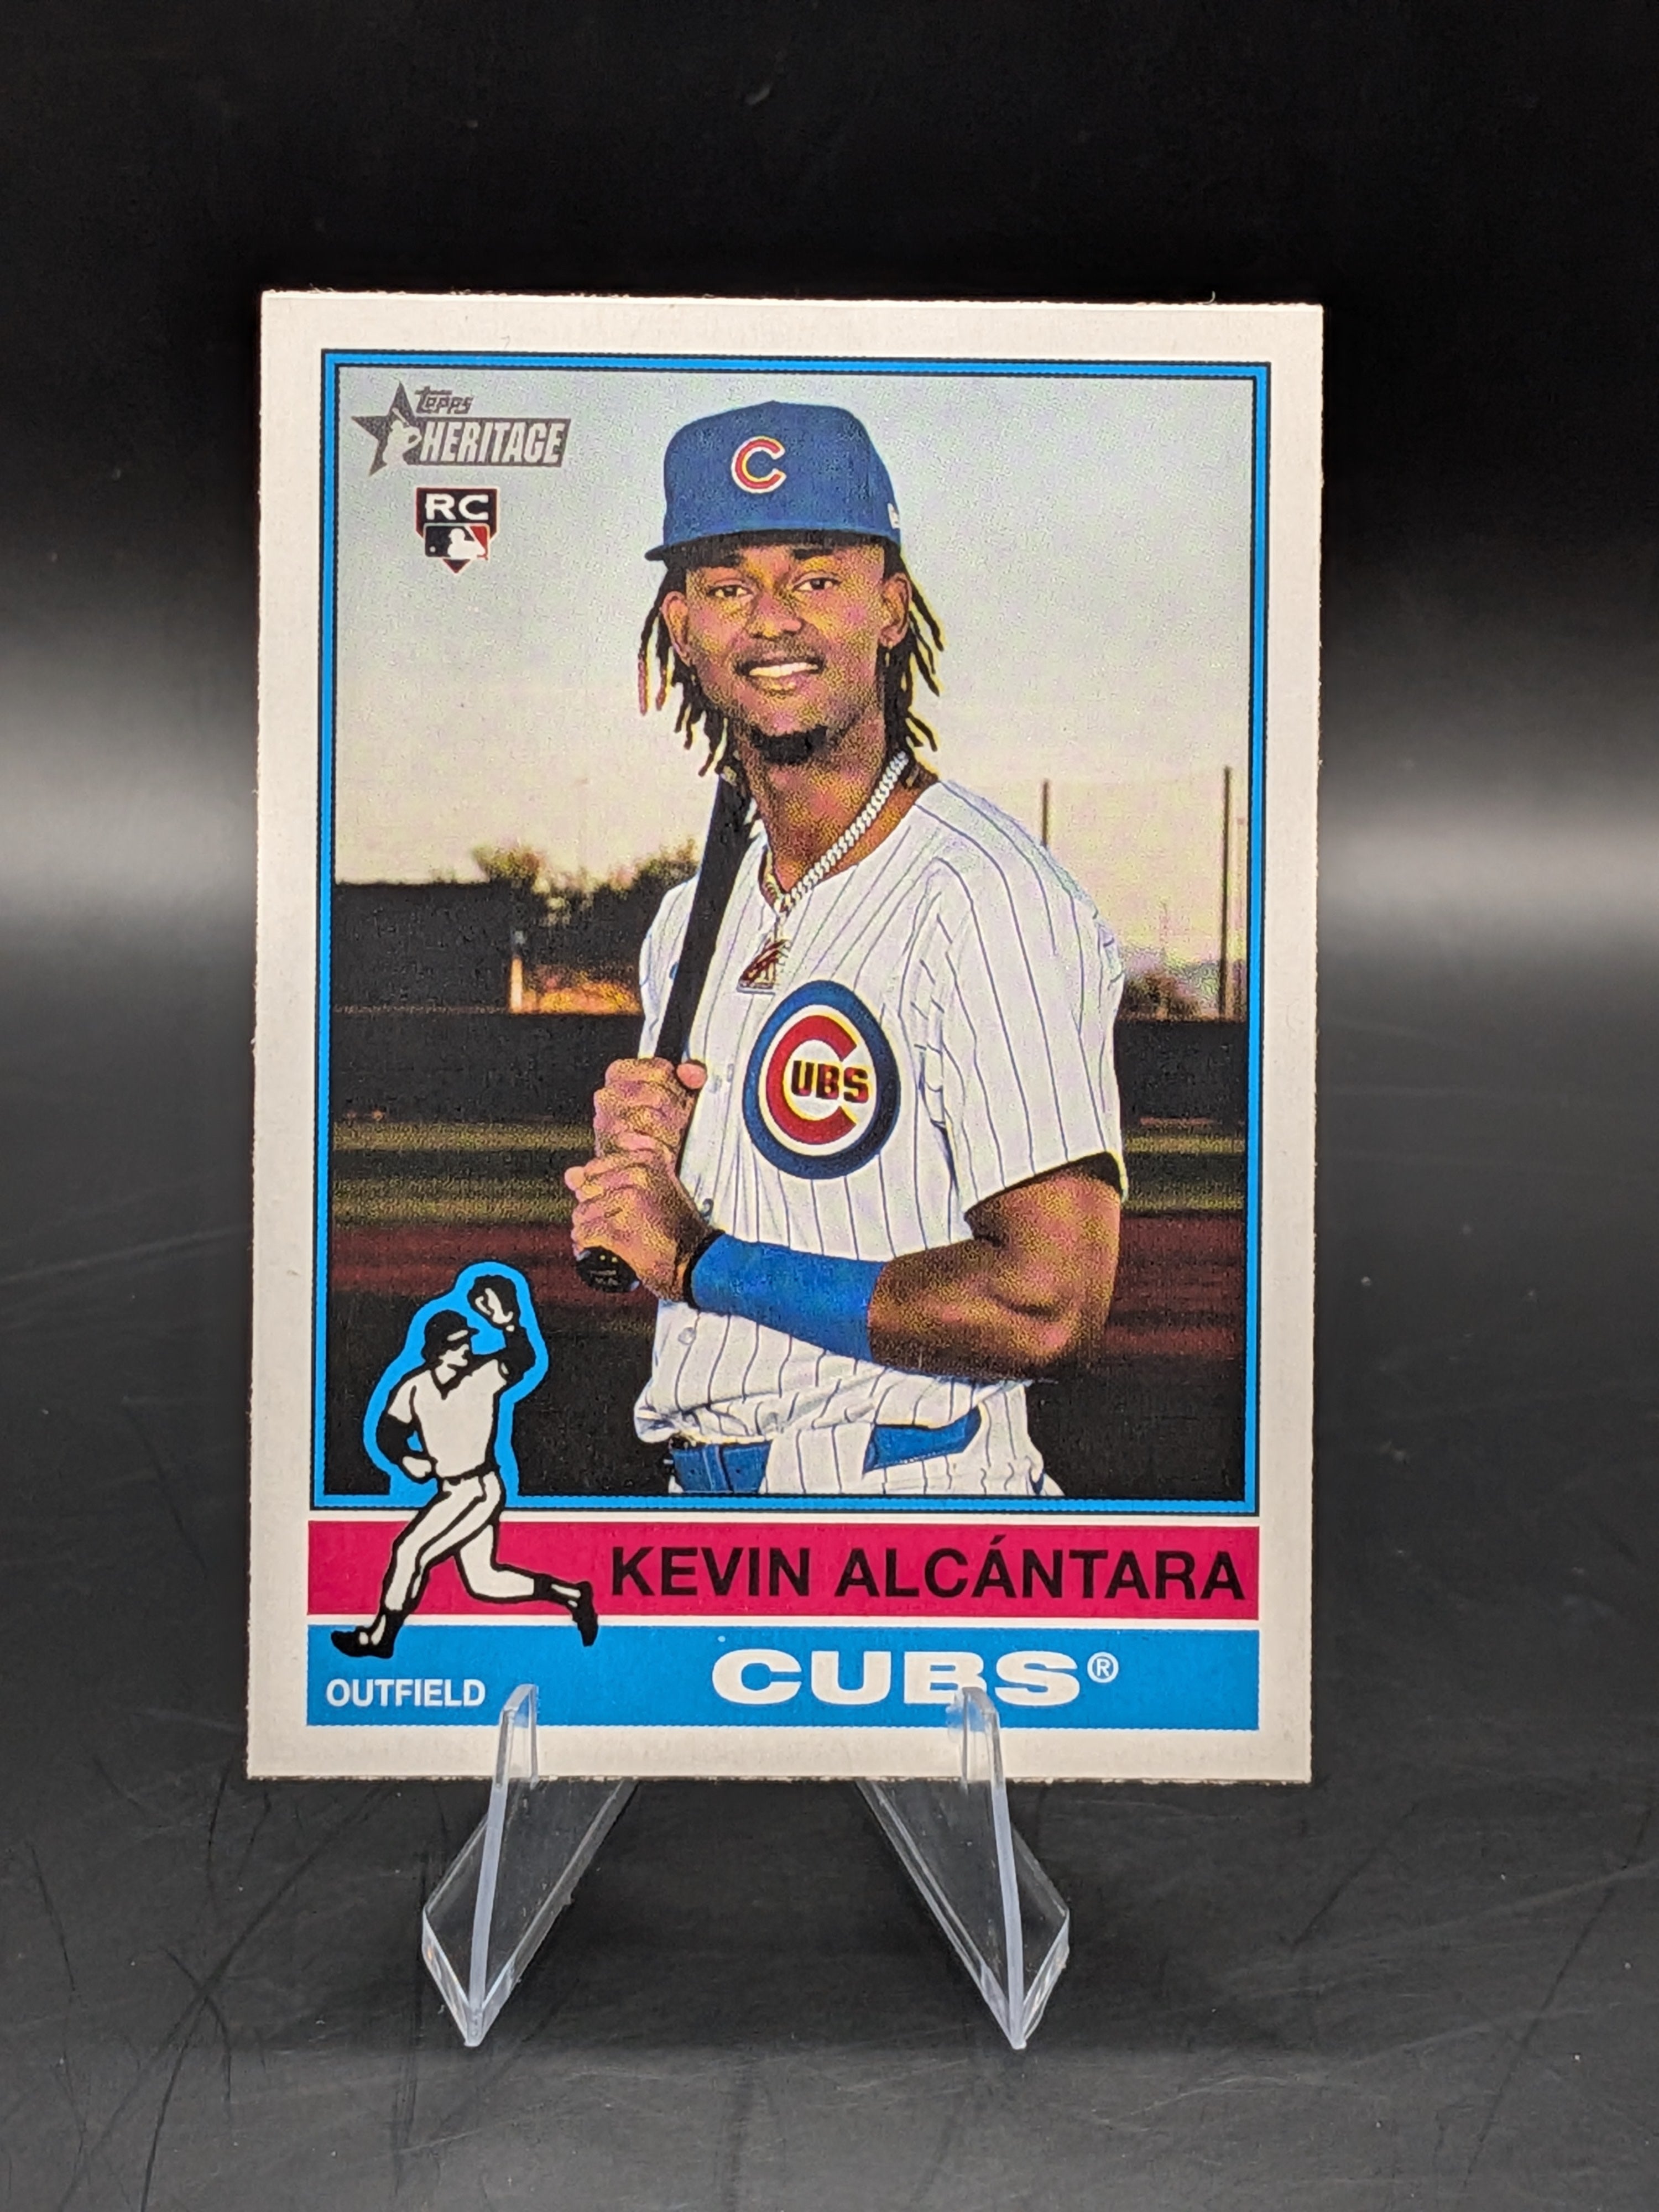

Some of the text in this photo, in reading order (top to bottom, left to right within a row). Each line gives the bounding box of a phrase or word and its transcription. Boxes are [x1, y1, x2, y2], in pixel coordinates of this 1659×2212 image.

[420, 421, 566, 464] HERITAGE
[731, 436, 786, 493] C
[425, 493, 489, 521] RC
[611, 1533, 1245, 1600] KEVIN ALCÁNTARA
[326, 1678, 486, 1708] OUTFIELD
